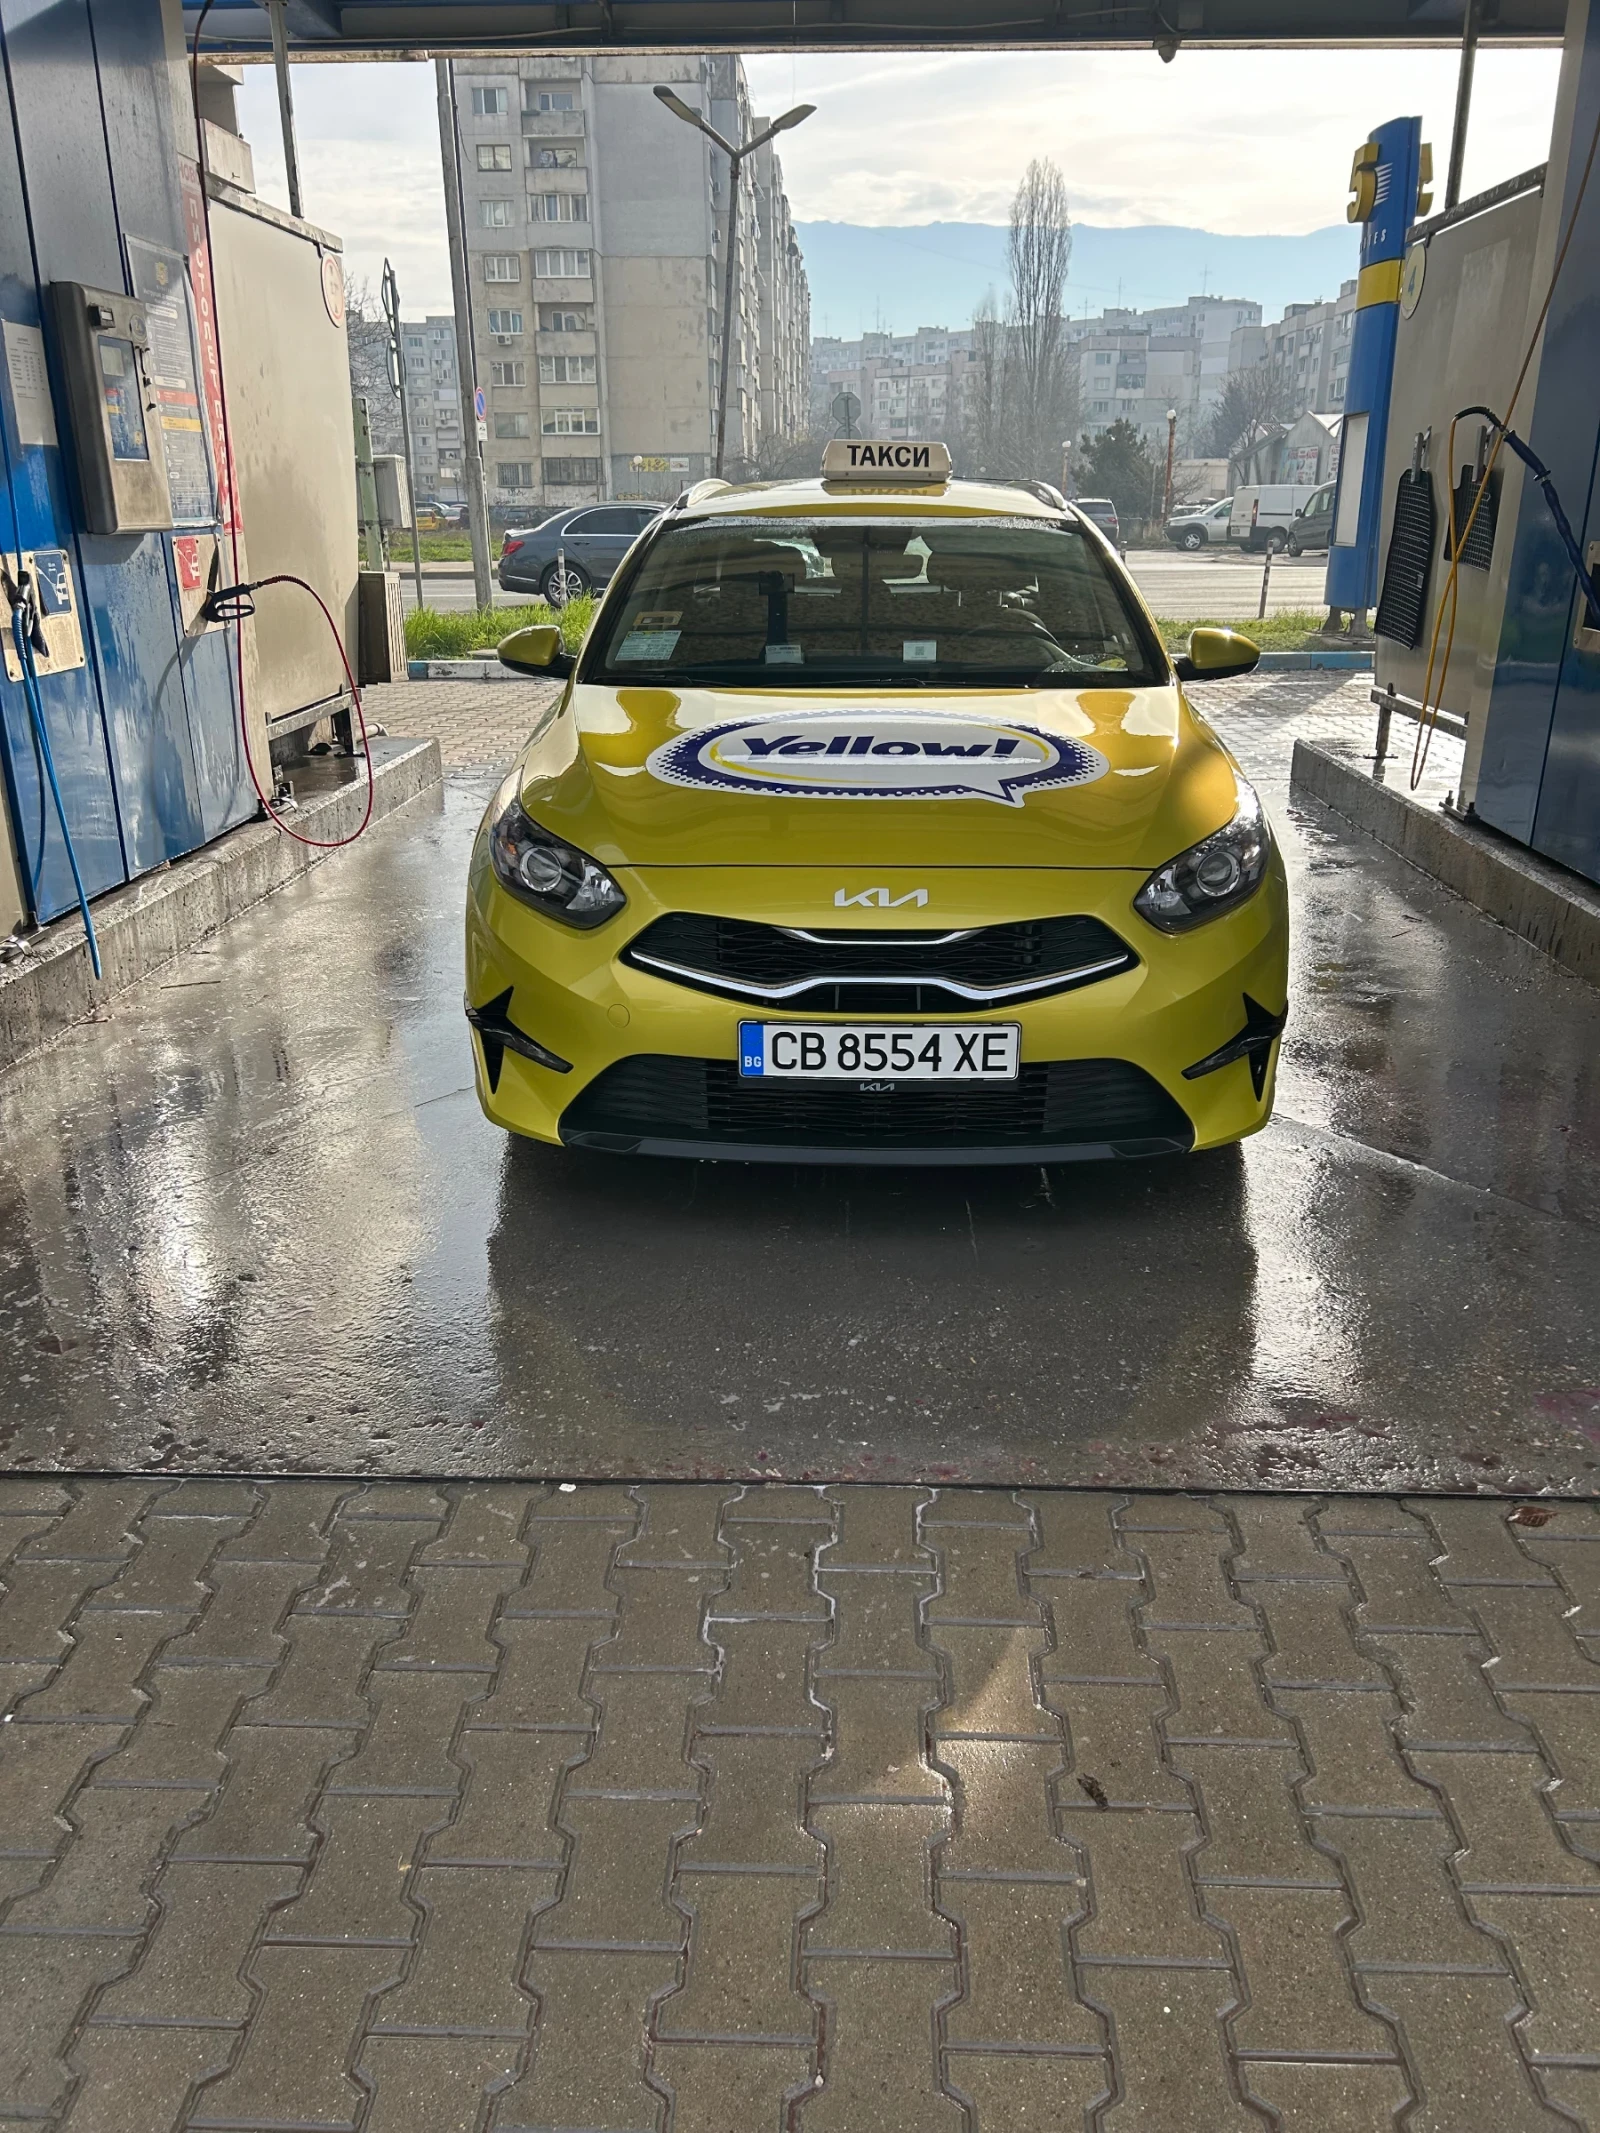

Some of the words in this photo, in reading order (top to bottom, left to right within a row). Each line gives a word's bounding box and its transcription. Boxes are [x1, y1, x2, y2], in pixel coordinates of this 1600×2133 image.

[1347, 142, 1380, 223] 5
[189, 198, 217, 388] ПИСТОЛЕТ
[1408, 266, 1417, 296] 4
[847, 445, 929, 467] ТАКСИ
[743, 735, 1020, 761] Yellow!
[744, 1056, 762, 1068] BG
[837, 1032, 942, 1072] 8554
